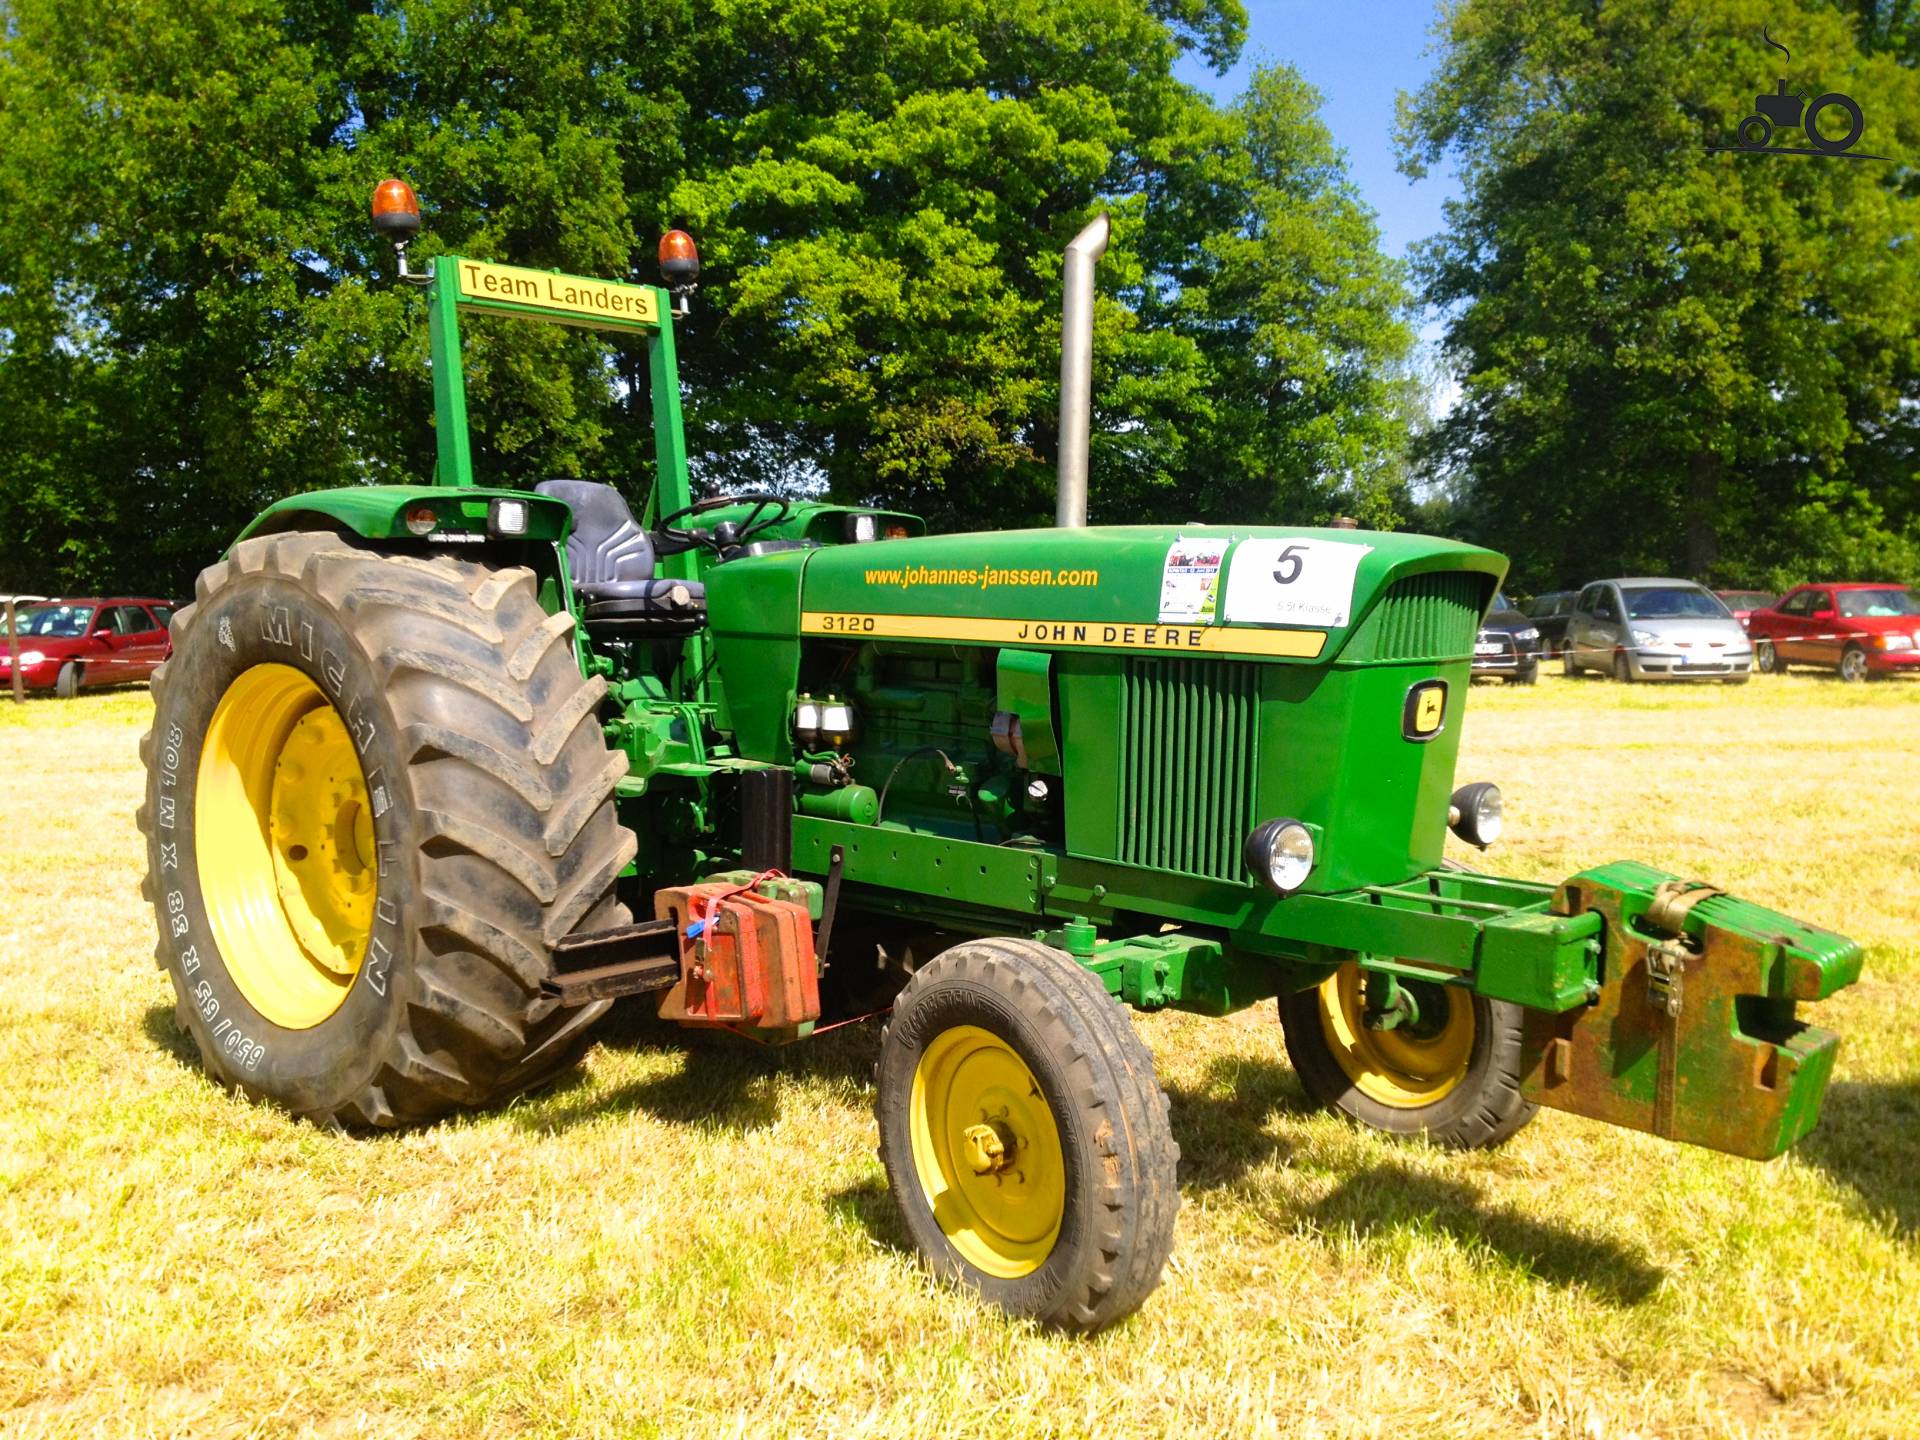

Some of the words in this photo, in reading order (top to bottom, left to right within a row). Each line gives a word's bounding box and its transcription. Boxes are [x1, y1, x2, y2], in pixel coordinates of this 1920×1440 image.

[464, 264, 538, 298] Team
[548, 278, 648, 315] Landers
[864, 564, 1098, 590] www.johannes-janssen.com
[1271, 545, 1310, 585] 5
[822, 615, 876, 631] 3120
[1018, 624, 1087, 642] JOHN
[1103, 627, 1202, 647] DEERE
